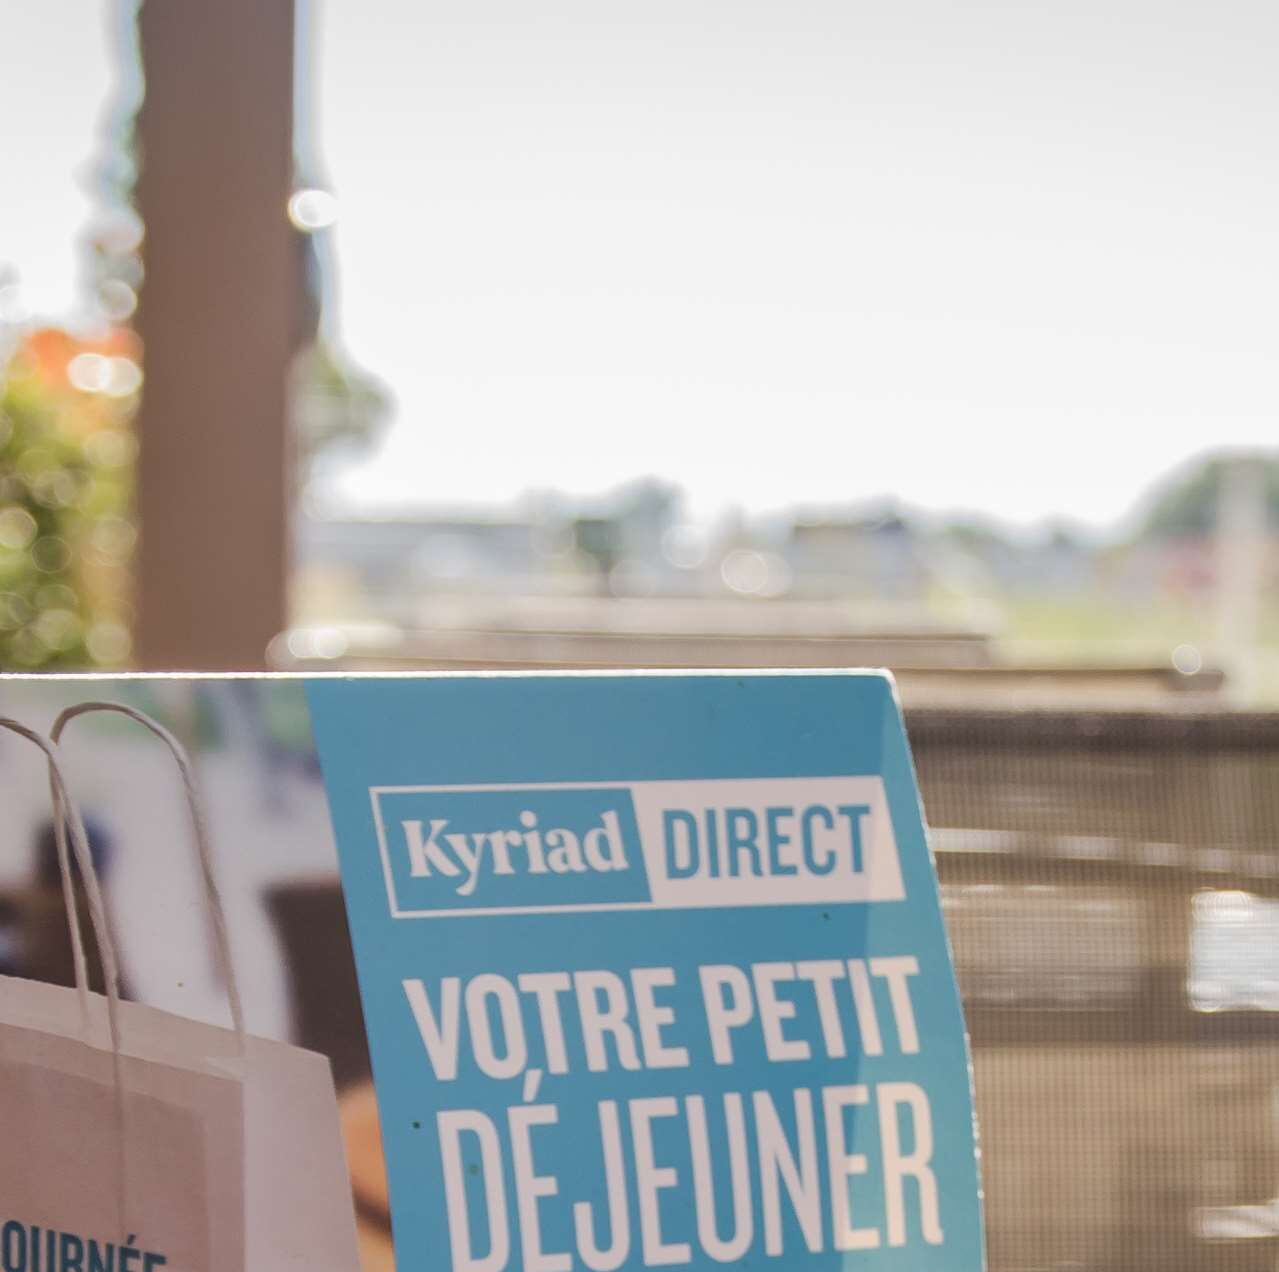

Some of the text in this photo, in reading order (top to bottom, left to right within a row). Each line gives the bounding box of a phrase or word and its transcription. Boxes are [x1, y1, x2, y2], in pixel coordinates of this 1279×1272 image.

[401, 804, 871, 896] Kyriad DIRECT
[403, 955, 920, 1081] VOTRE PETIT
